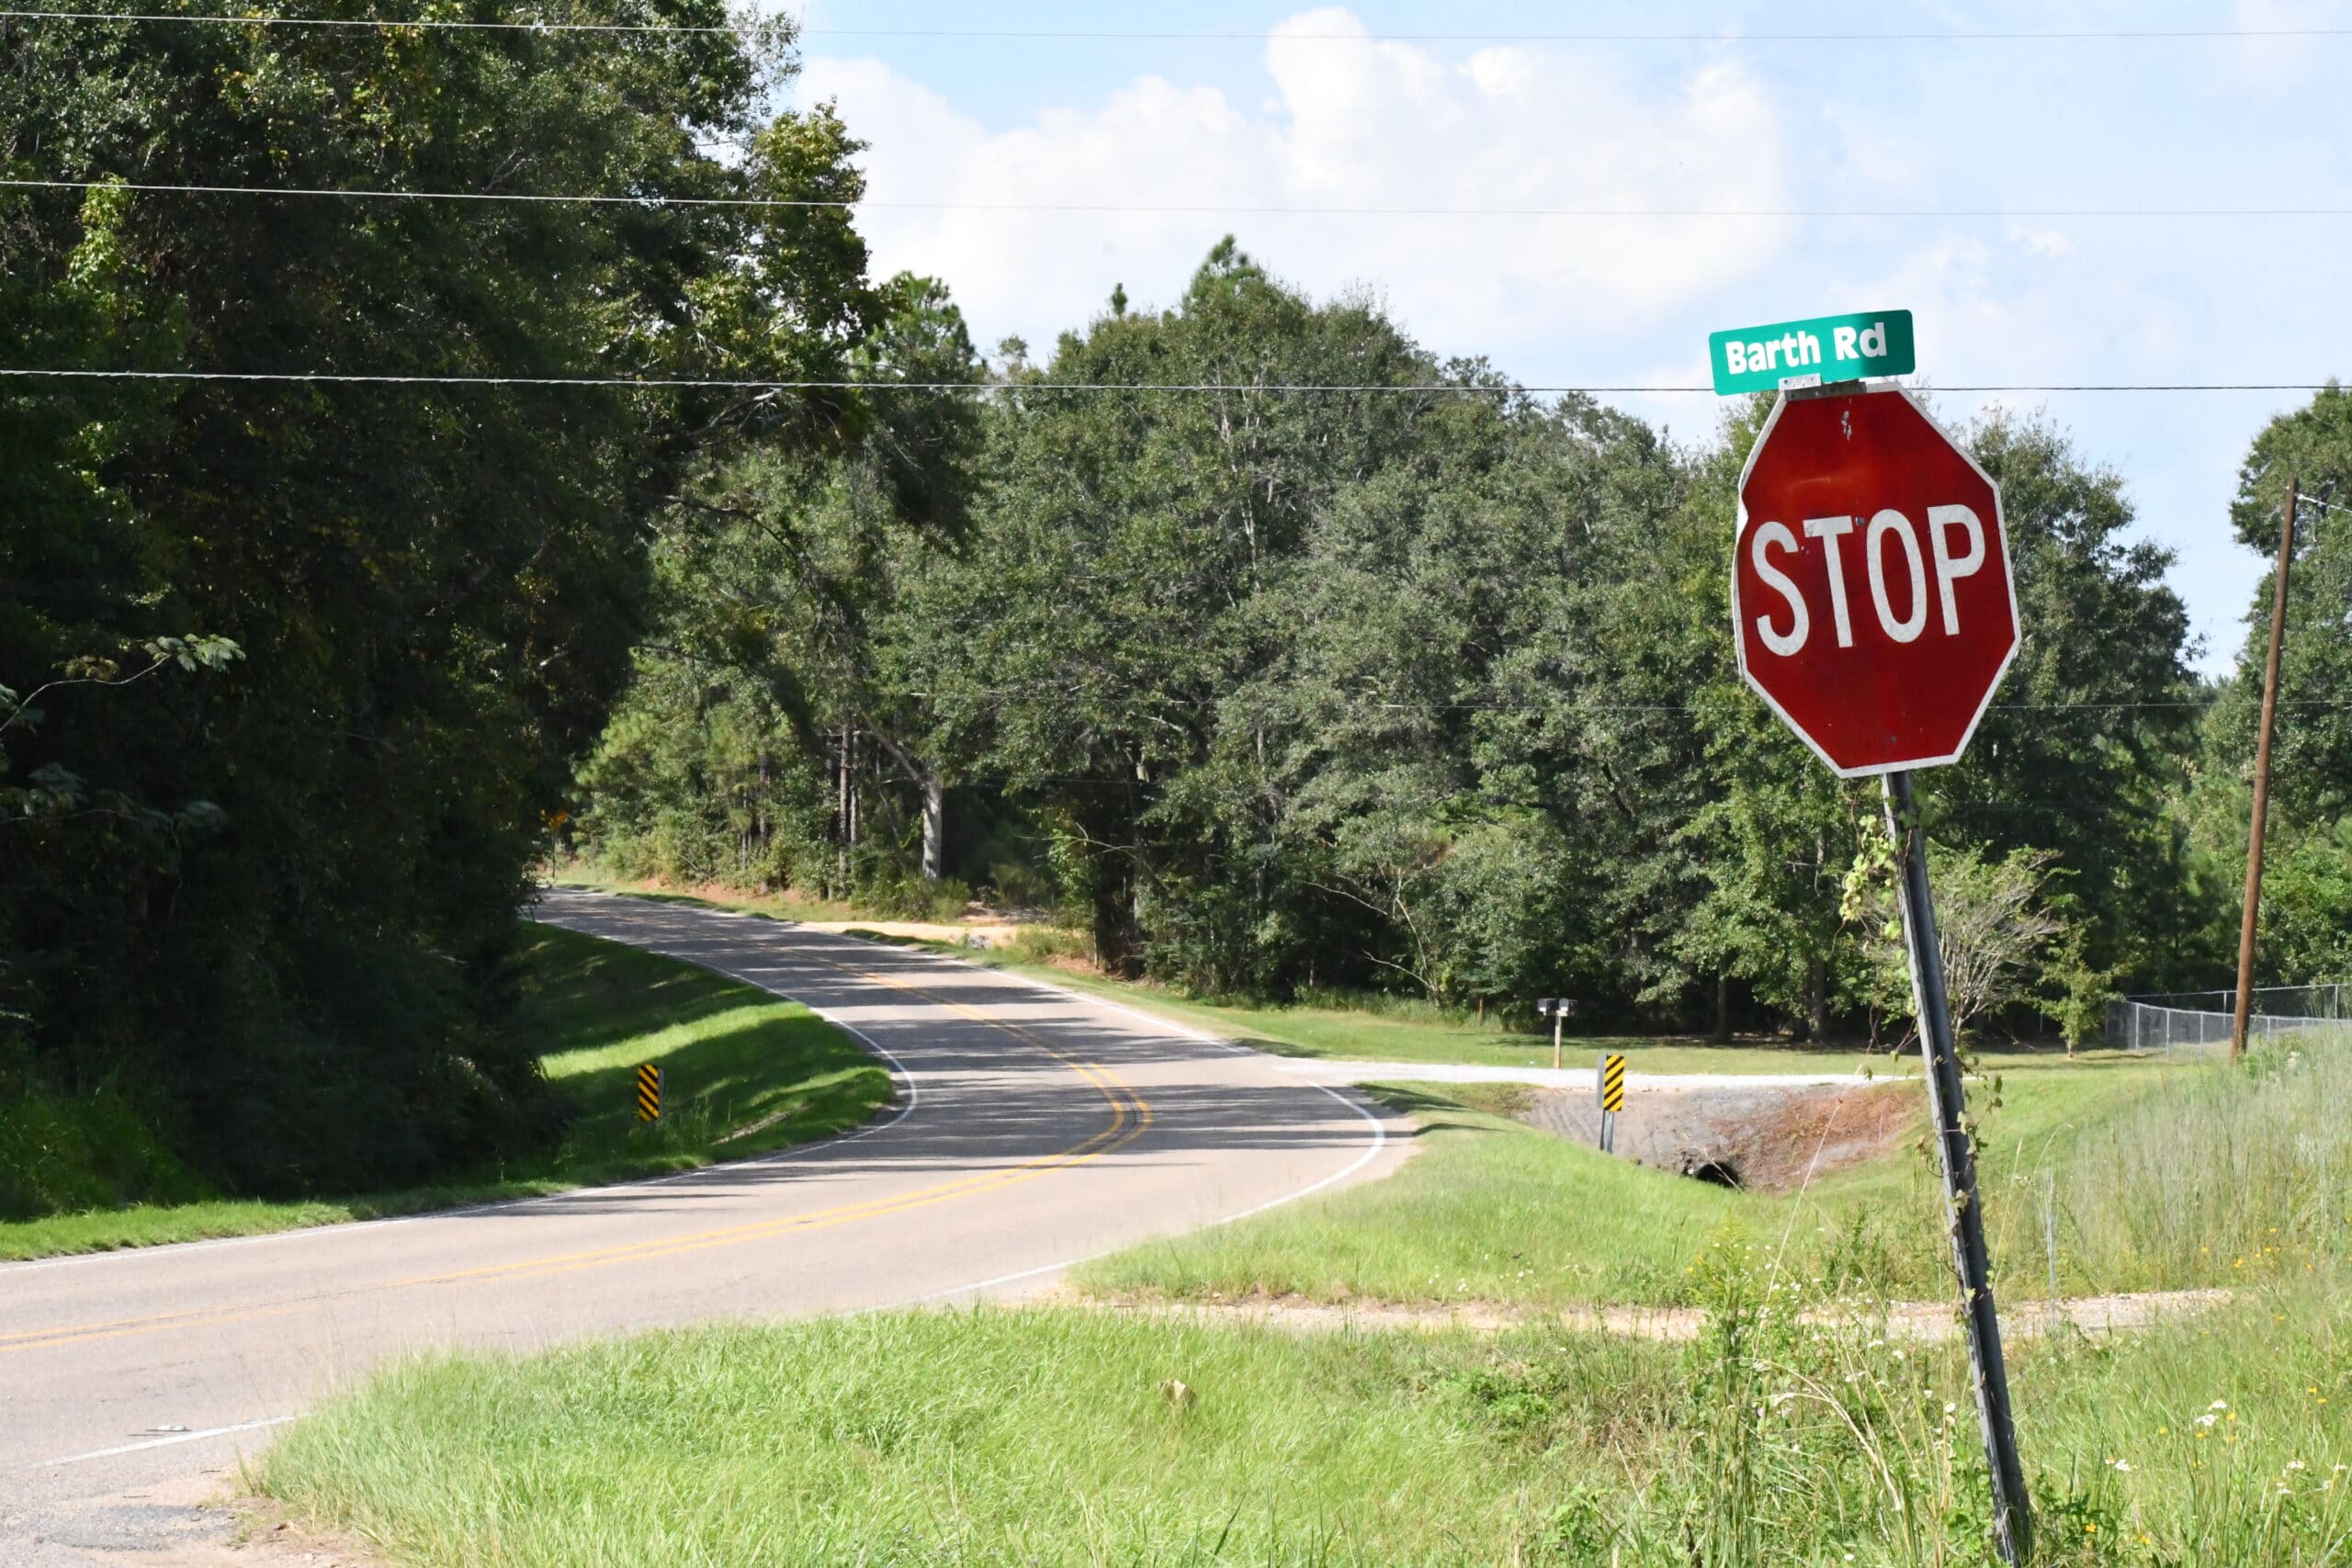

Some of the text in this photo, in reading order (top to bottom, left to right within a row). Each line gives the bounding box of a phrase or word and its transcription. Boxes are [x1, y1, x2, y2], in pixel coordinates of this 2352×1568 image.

[1725, 322, 1887, 375] Barth Rd
[1751, 504, 1985, 657] STOP
